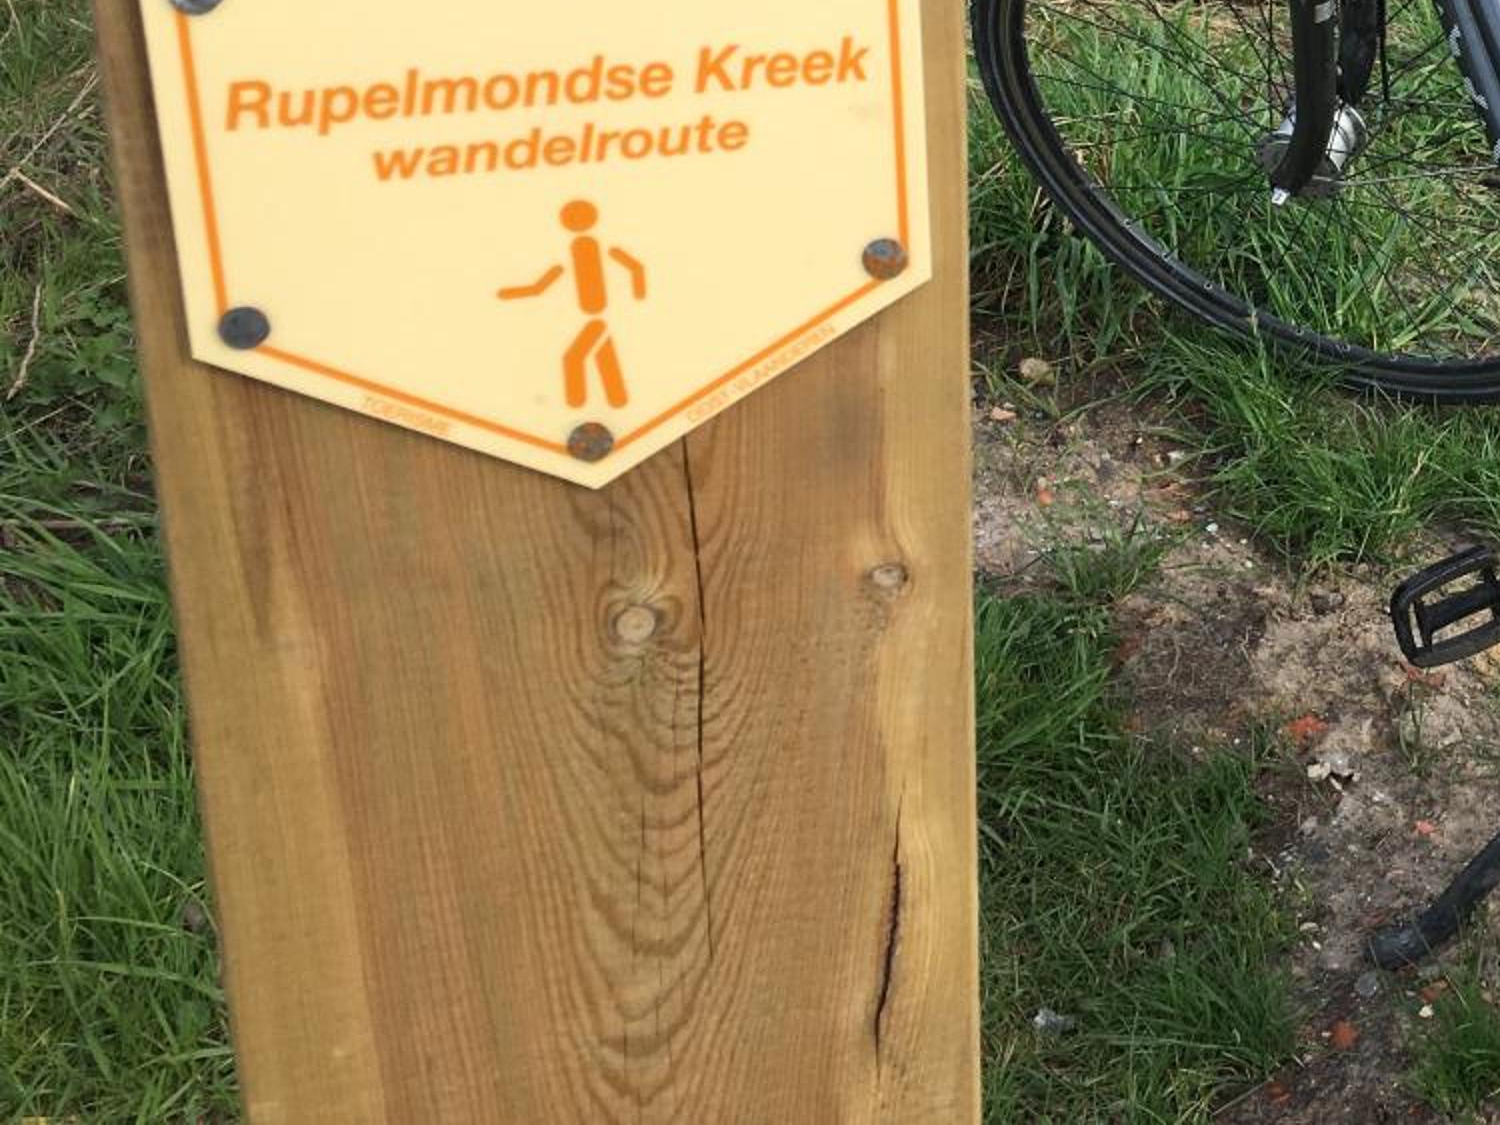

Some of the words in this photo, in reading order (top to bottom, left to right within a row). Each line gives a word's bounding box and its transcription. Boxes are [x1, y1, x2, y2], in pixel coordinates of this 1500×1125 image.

[223, 54, 674, 137] Rupelmondse
[694, 35, 870, 94] Kreek
[372, 114, 750, 182] wandelroute
